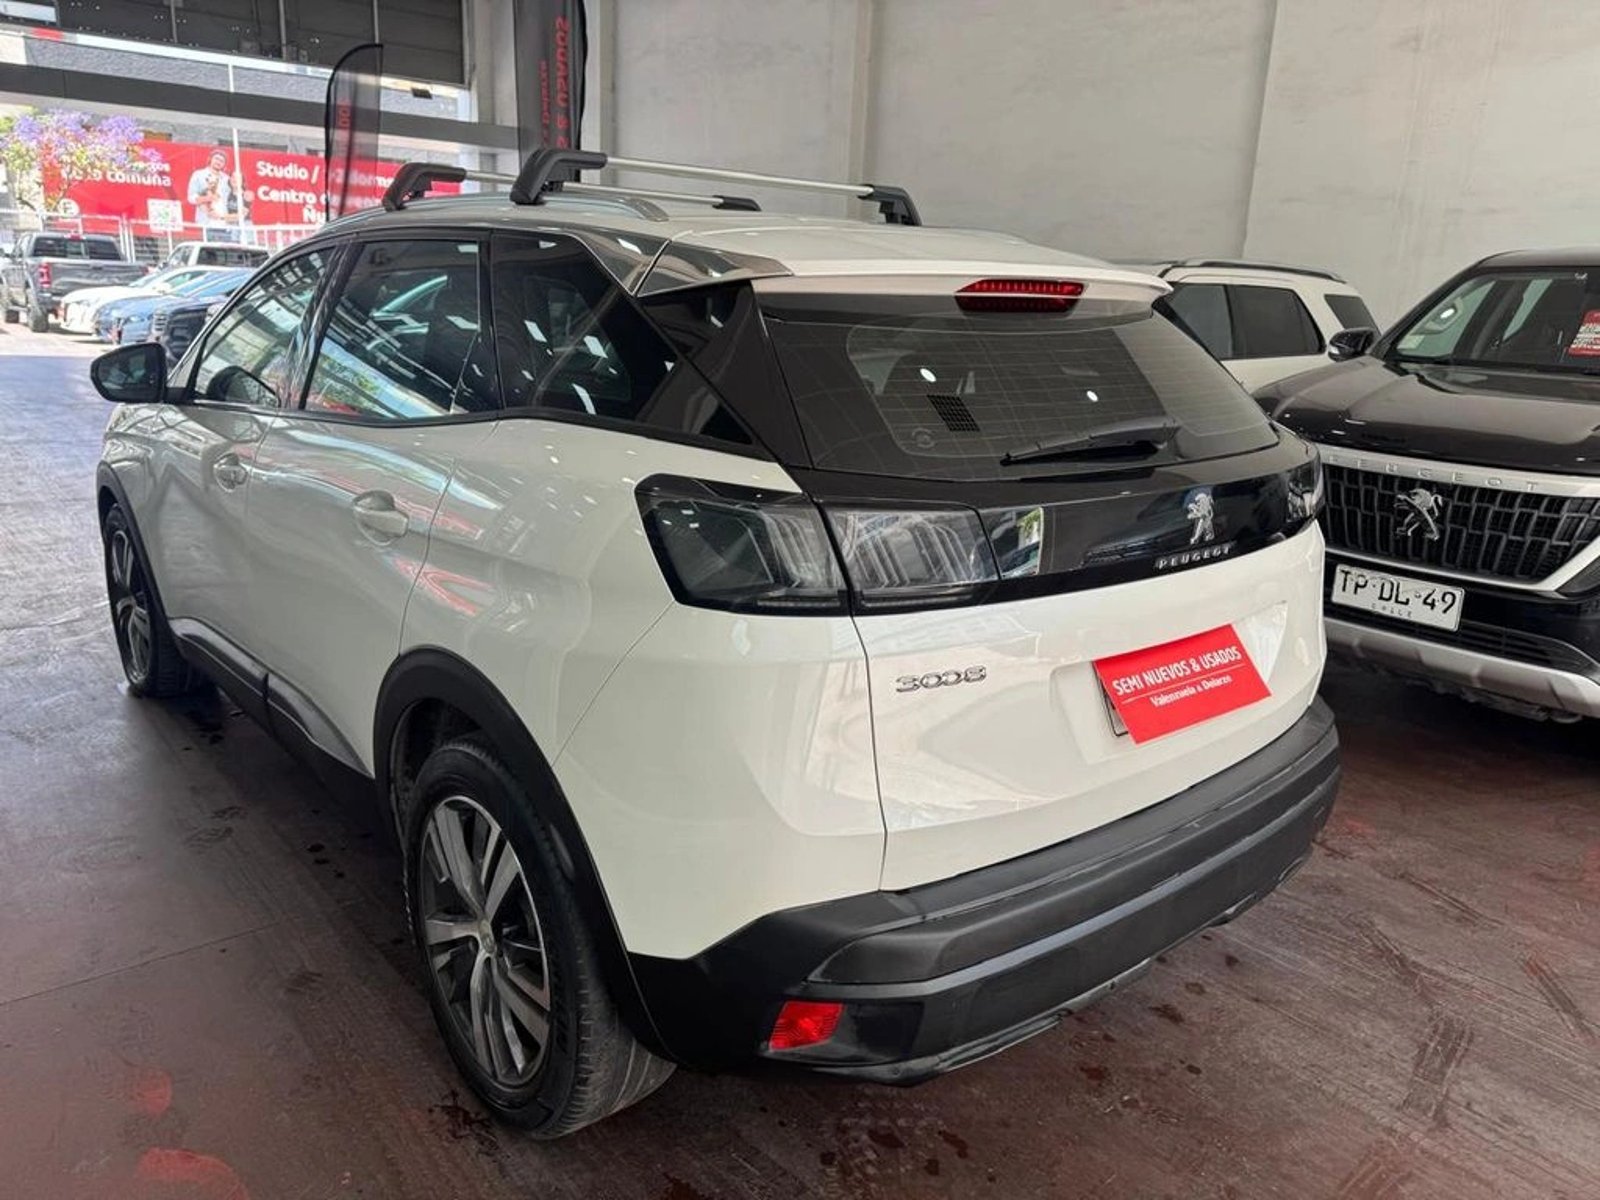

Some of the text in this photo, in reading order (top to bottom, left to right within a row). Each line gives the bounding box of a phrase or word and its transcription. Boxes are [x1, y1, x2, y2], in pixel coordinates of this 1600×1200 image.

[256, 160, 309, 181] Studio
[257, 186, 317, 204] Centro
[1329, 455, 1539, 492] PEUGEOT
[1154, 540, 1236, 570] PEUGEOT
[895, 665, 987, 692] 3008
[1112, 646, 1242, 696] SEMI NUEVOS & USADOS
[1150, 685, 1197, 707] Valenzuela
